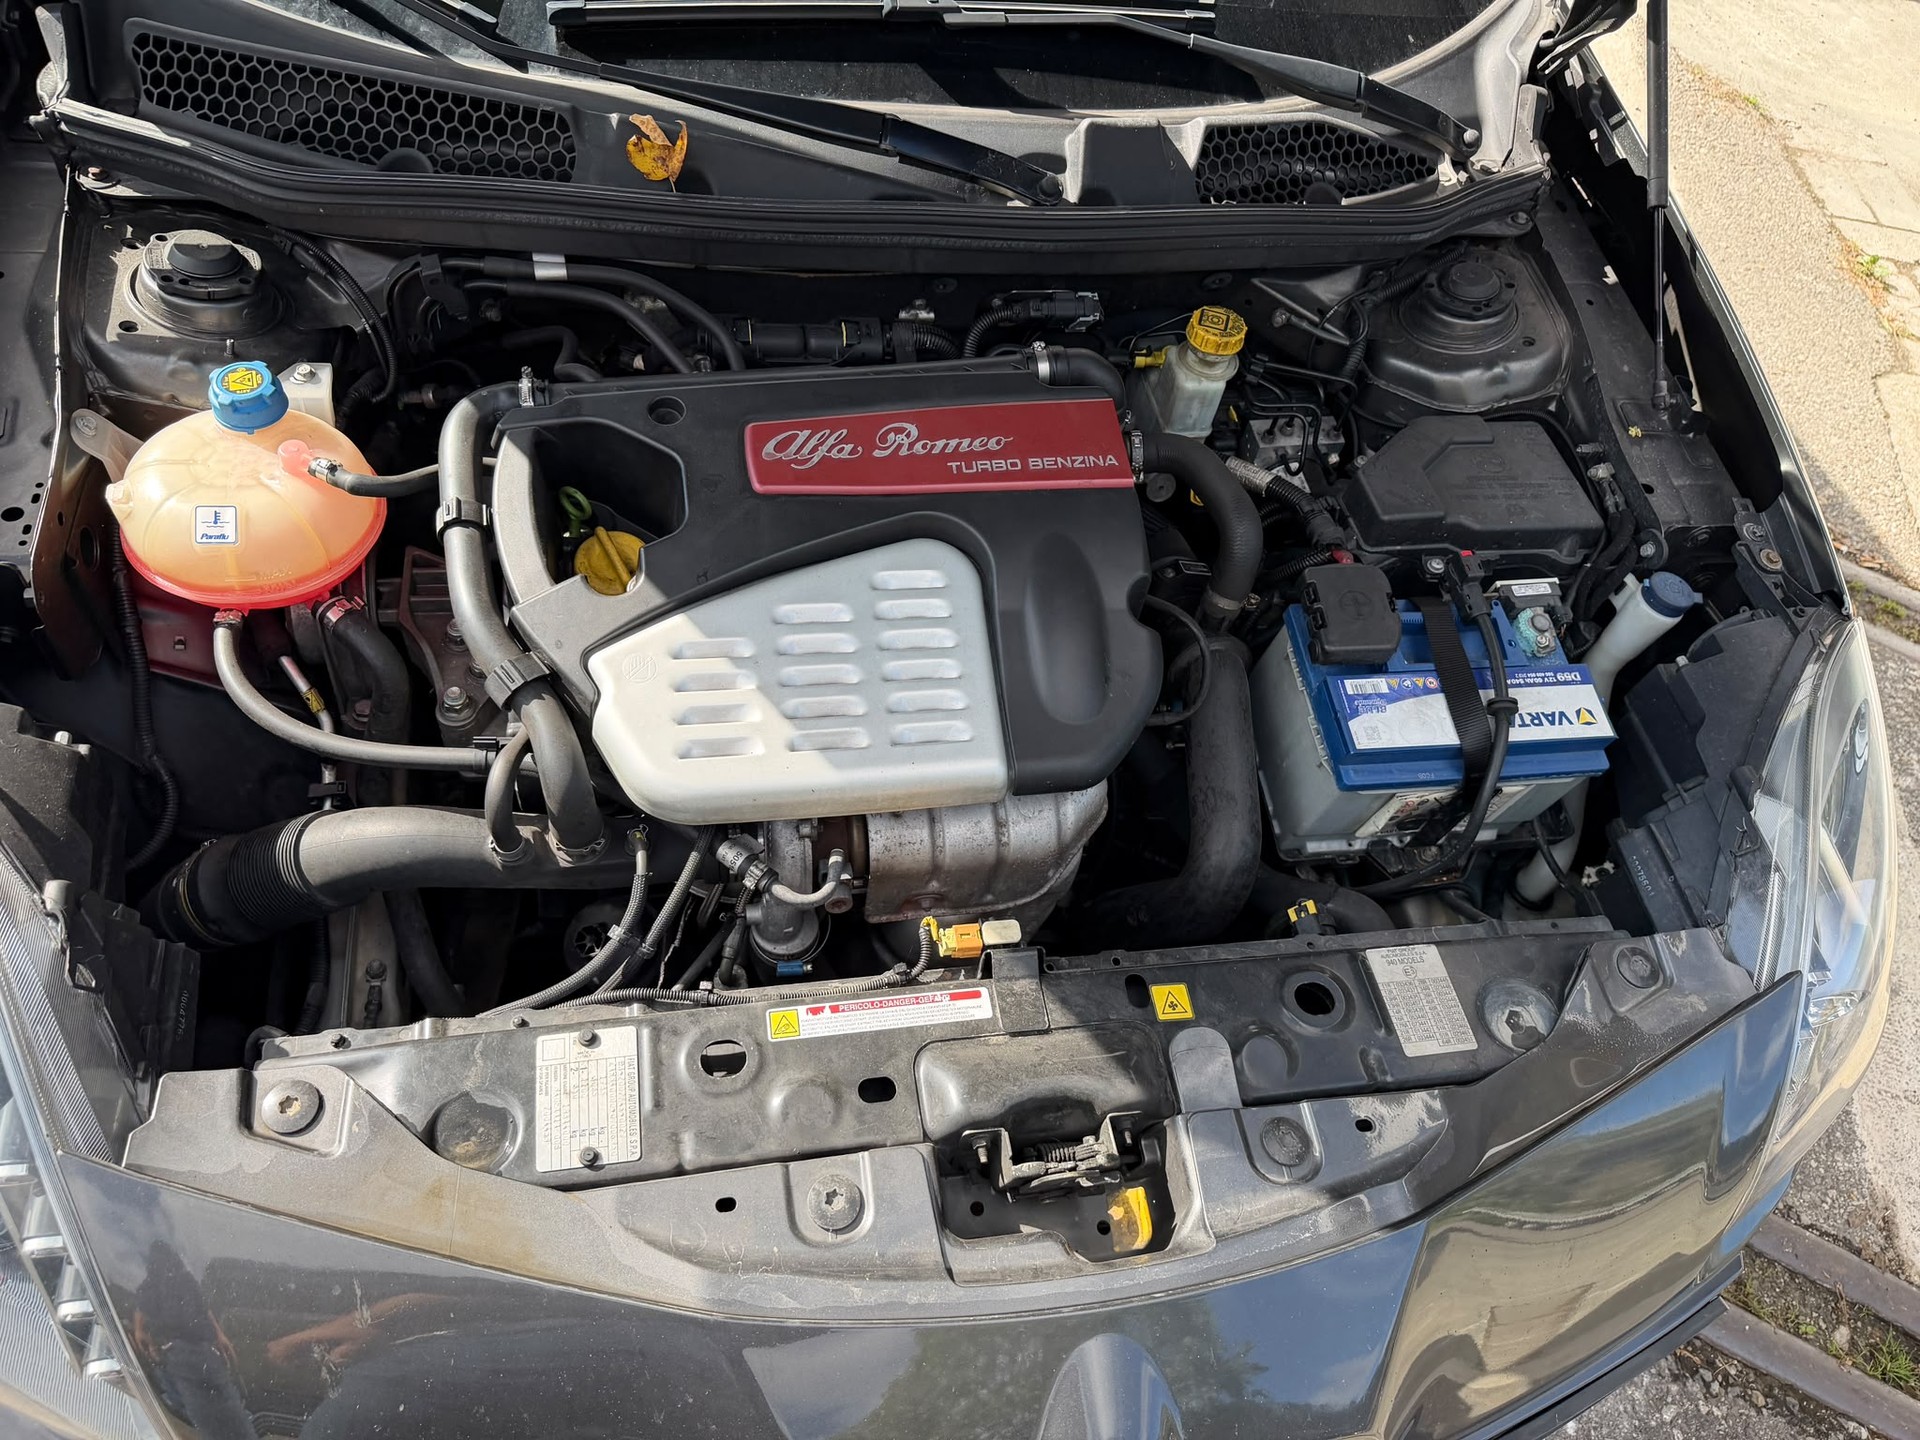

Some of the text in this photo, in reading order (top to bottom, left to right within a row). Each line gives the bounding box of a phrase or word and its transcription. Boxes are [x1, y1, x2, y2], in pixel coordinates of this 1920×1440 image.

[762, 421, 1014, 470] Alfa Romeo
[947, 454, 1119, 475] TURBO BENZINA
[200, 532, 230, 541] Paraflu
[1556, 671, 1582, 681] D59
[1385, 956, 1425, 967] 940 MODELS
[627, 1057, 636, 1070] FIAT
[627, 1071, 637, 1093] GROUP
[628, 1093, 638, 1137] AUTOMOBILES
